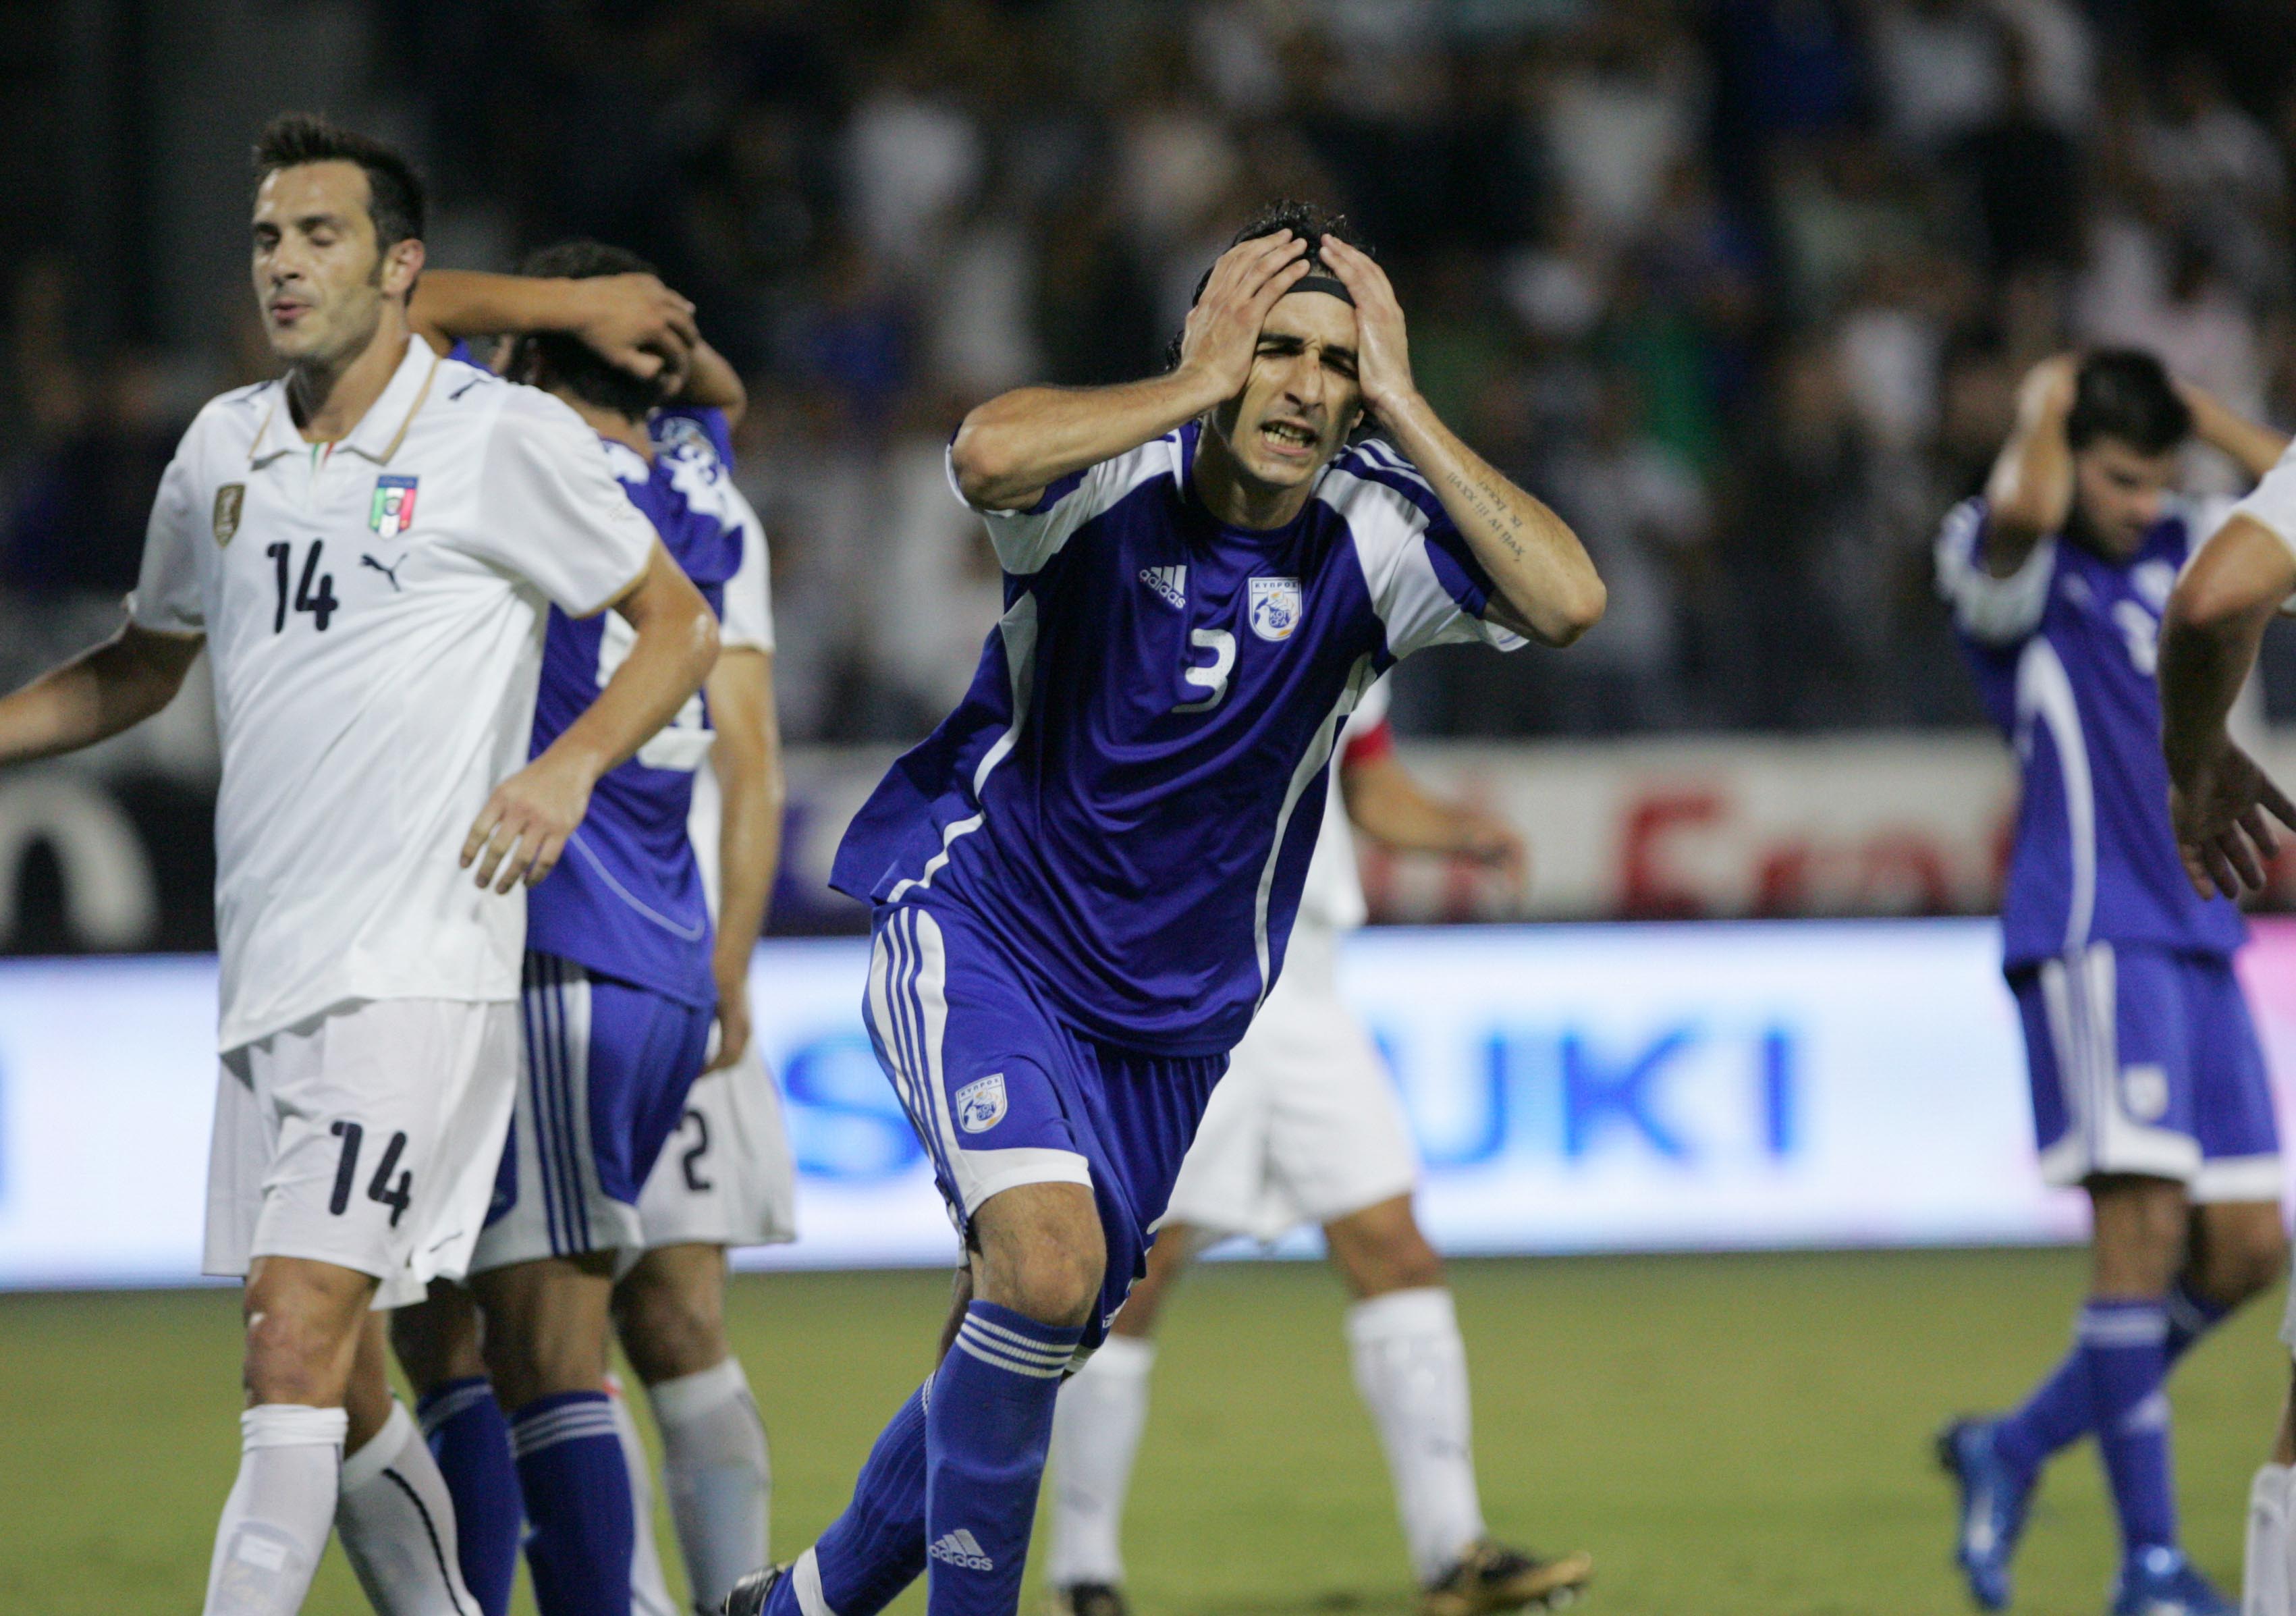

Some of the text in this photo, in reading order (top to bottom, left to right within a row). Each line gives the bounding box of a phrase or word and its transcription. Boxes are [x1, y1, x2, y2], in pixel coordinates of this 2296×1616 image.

[266, 539, 339, 634] 14
[1139, 569, 1186, 609] adidas
[1171, 628, 1236, 713] 3
[329, 1121, 412, 1228] 14
[676, 1109, 711, 1191] 2
[928, 1544, 993, 1571] adidas
